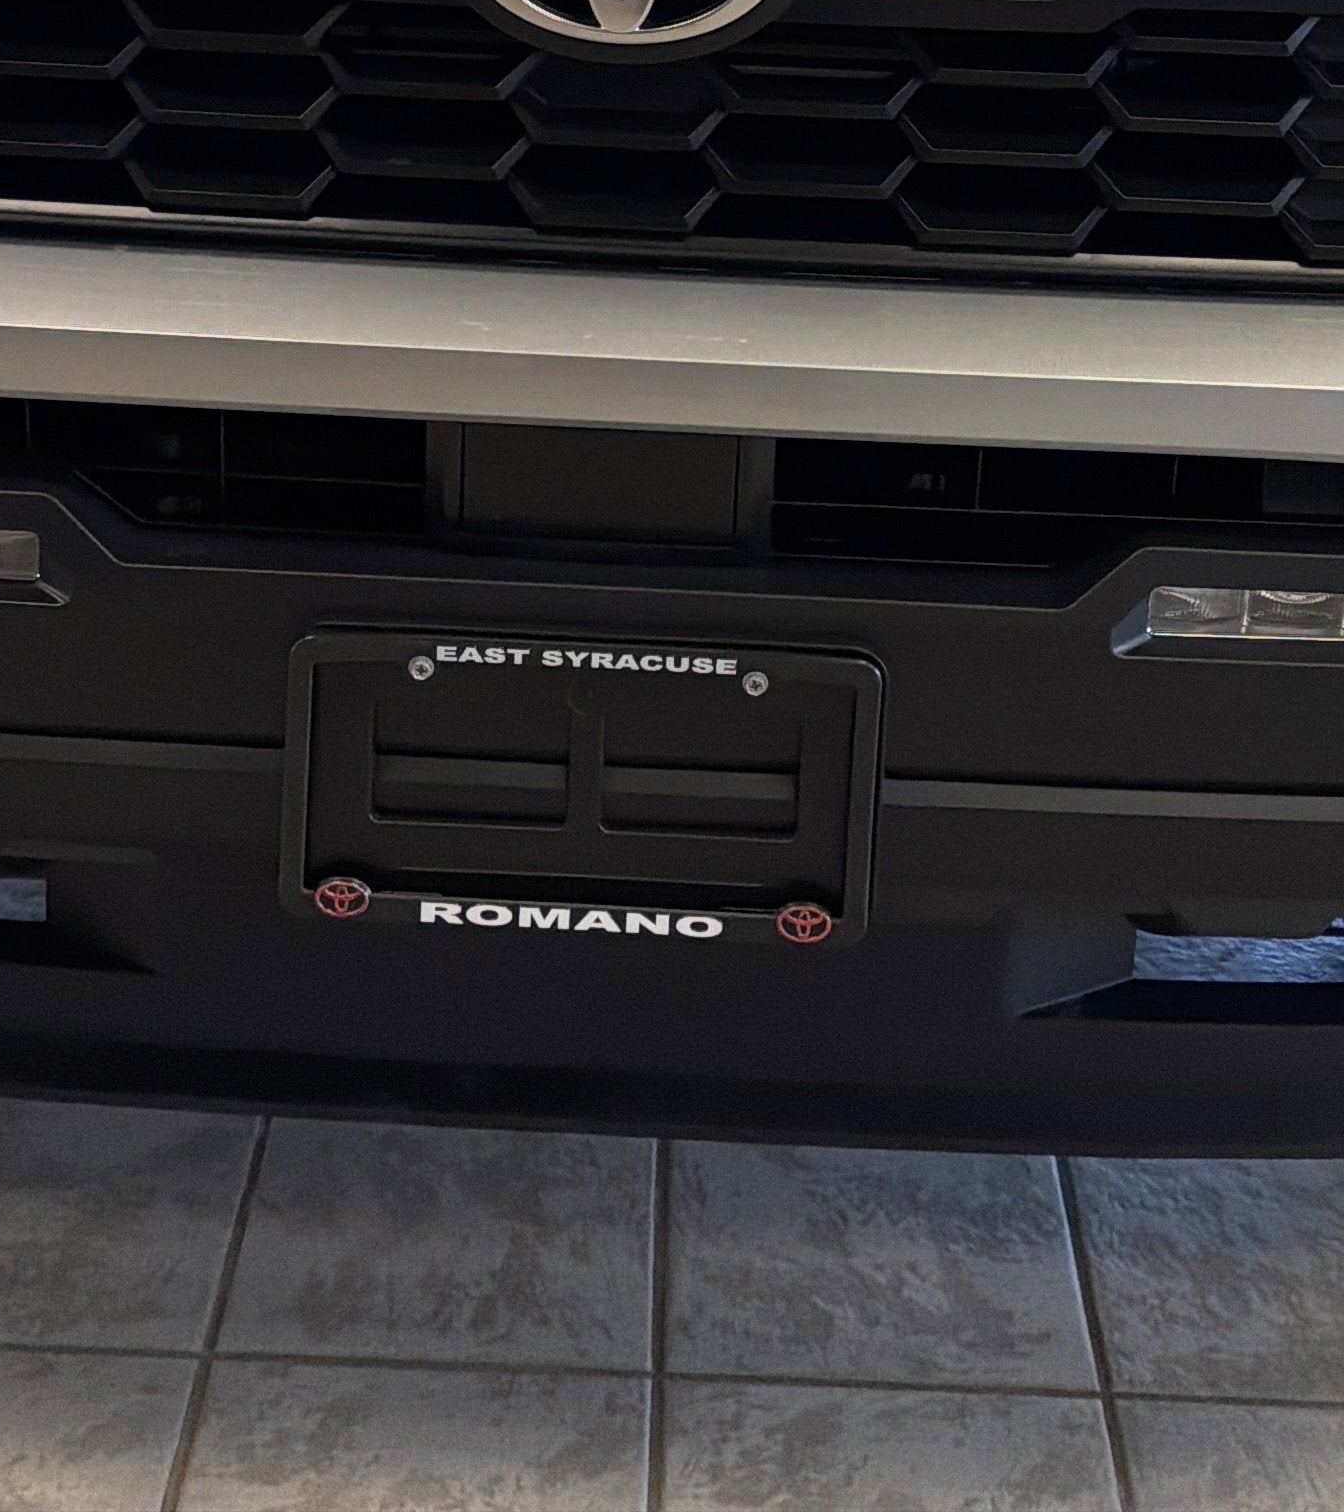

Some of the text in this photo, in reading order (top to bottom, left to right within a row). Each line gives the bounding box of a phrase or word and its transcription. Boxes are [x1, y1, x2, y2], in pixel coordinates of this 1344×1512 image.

[436, 645, 738, 675] EAST SYRACUSE
[420, 901, 723, 938] ROMANO
